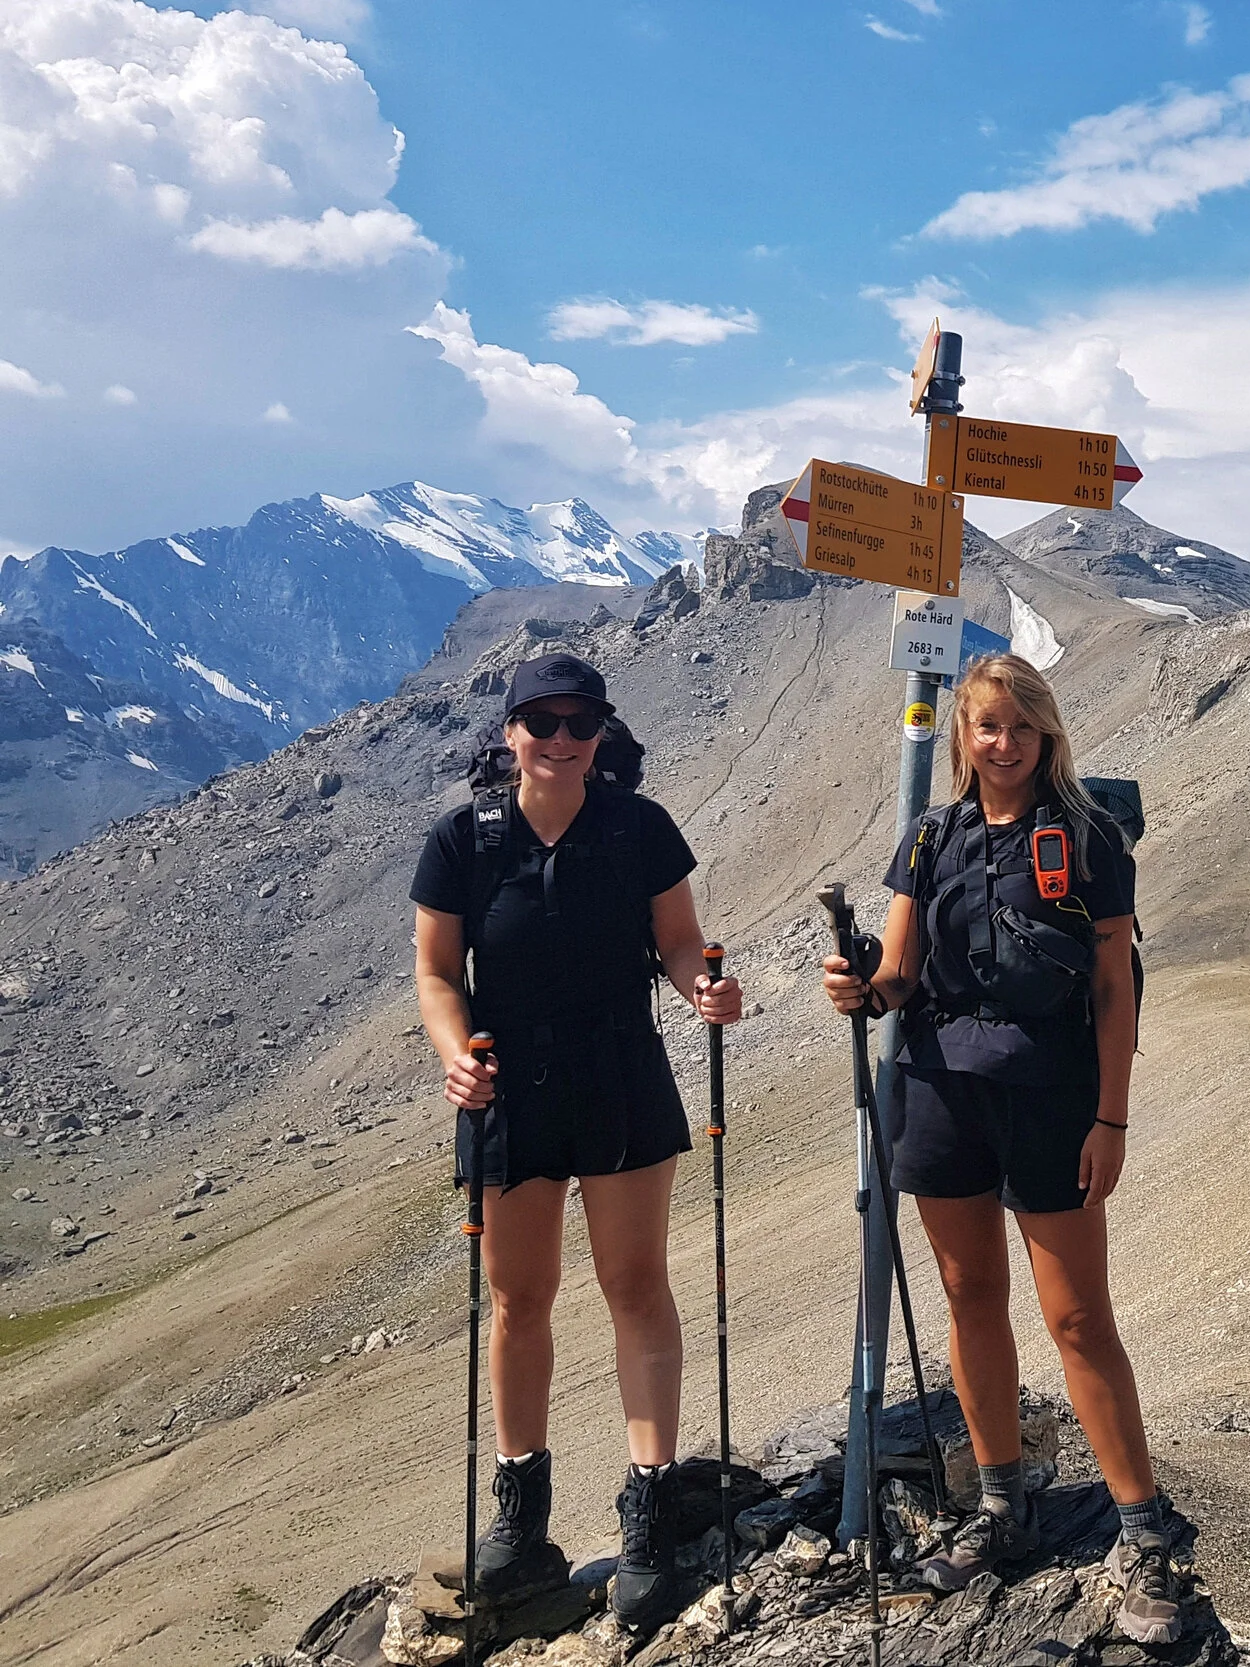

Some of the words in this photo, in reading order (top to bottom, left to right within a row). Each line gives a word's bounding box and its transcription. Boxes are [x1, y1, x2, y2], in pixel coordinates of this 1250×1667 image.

[968, 424, 1007, 442] Hochie
[966, 447, 1042, 469] Glütschnessli
[820, 468, 888, 499] Rotstockhütte
[964, 472, 1006, 490] Kiental
[818, 493, 854, 515] Mürren
[910, 516, 923, 531] 3h
[816, 520, 885, 551] Sefinenfurgge
[815, 545, 856, 570] Griesalp
[905, 609, 927, 623] Rote
[930, 612, 953, 625] Härd
[907, 641, 932, 655] 2683
[935, 646, 944, 656] m
[478, 808, 502, 822] BACH
